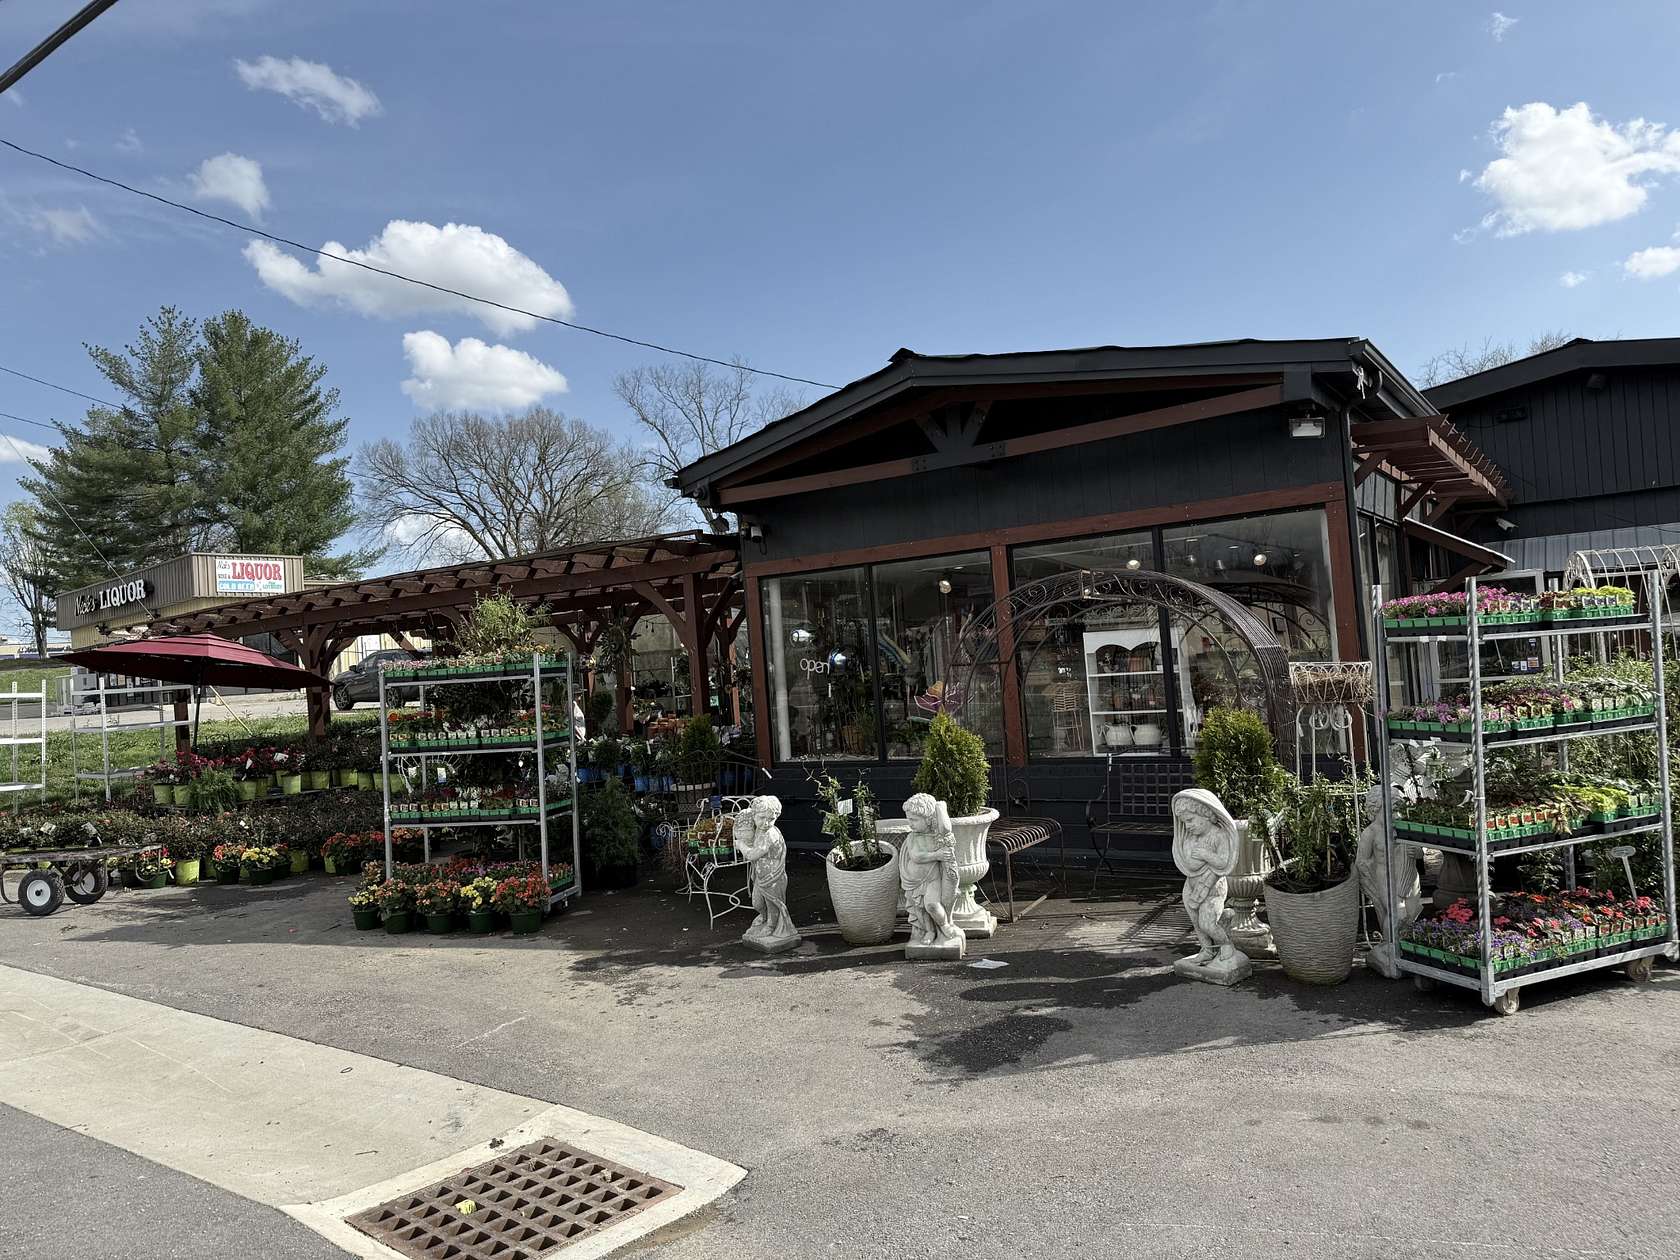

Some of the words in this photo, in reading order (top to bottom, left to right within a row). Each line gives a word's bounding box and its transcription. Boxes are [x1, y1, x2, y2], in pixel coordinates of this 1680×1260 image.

[232, 562, 282, 581] LIQUOR
[99, 579, 146, 610] LIQUOR
[800, 658, 830, 680] open
